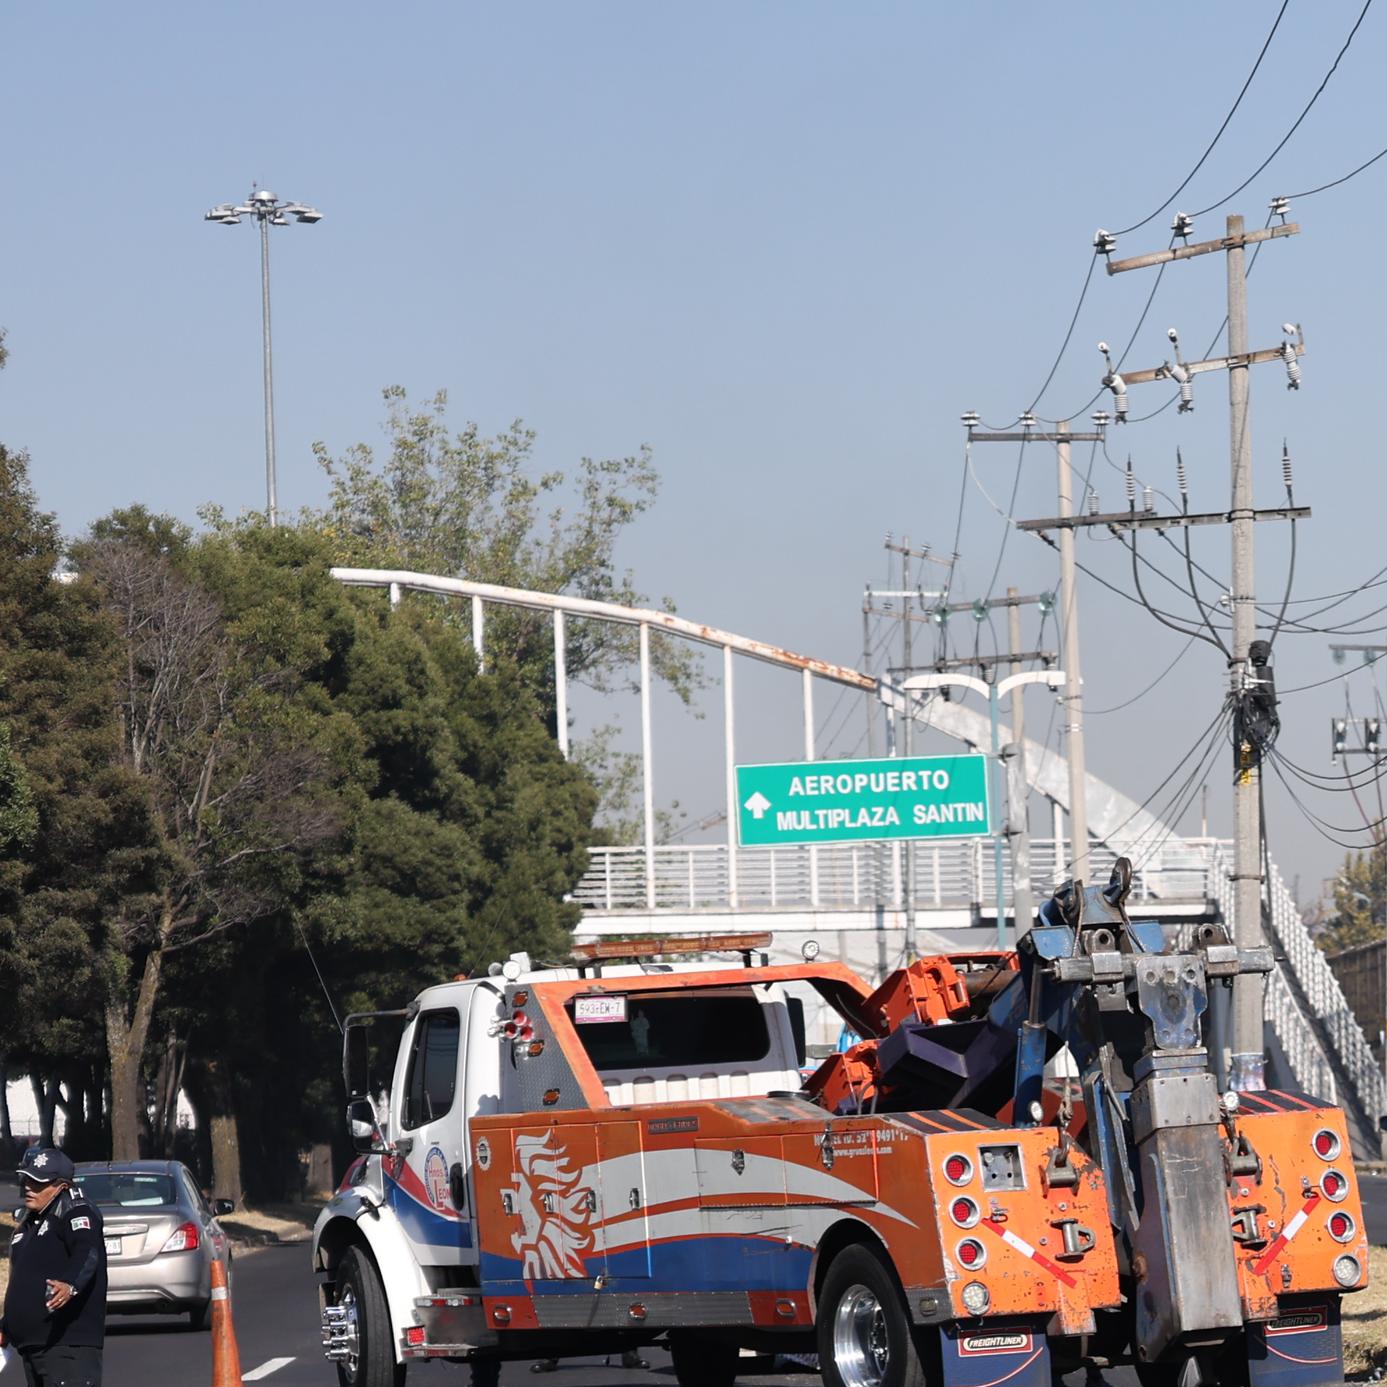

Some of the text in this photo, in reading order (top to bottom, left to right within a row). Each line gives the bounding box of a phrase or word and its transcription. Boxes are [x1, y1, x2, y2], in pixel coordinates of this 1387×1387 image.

[789, 769, 949, 796] AEROPUERTO
[776, 802, 984, 831] MULTIPLAZA SANTIN
[969, 1336, 1022, 1348] FREIGHTLINER
